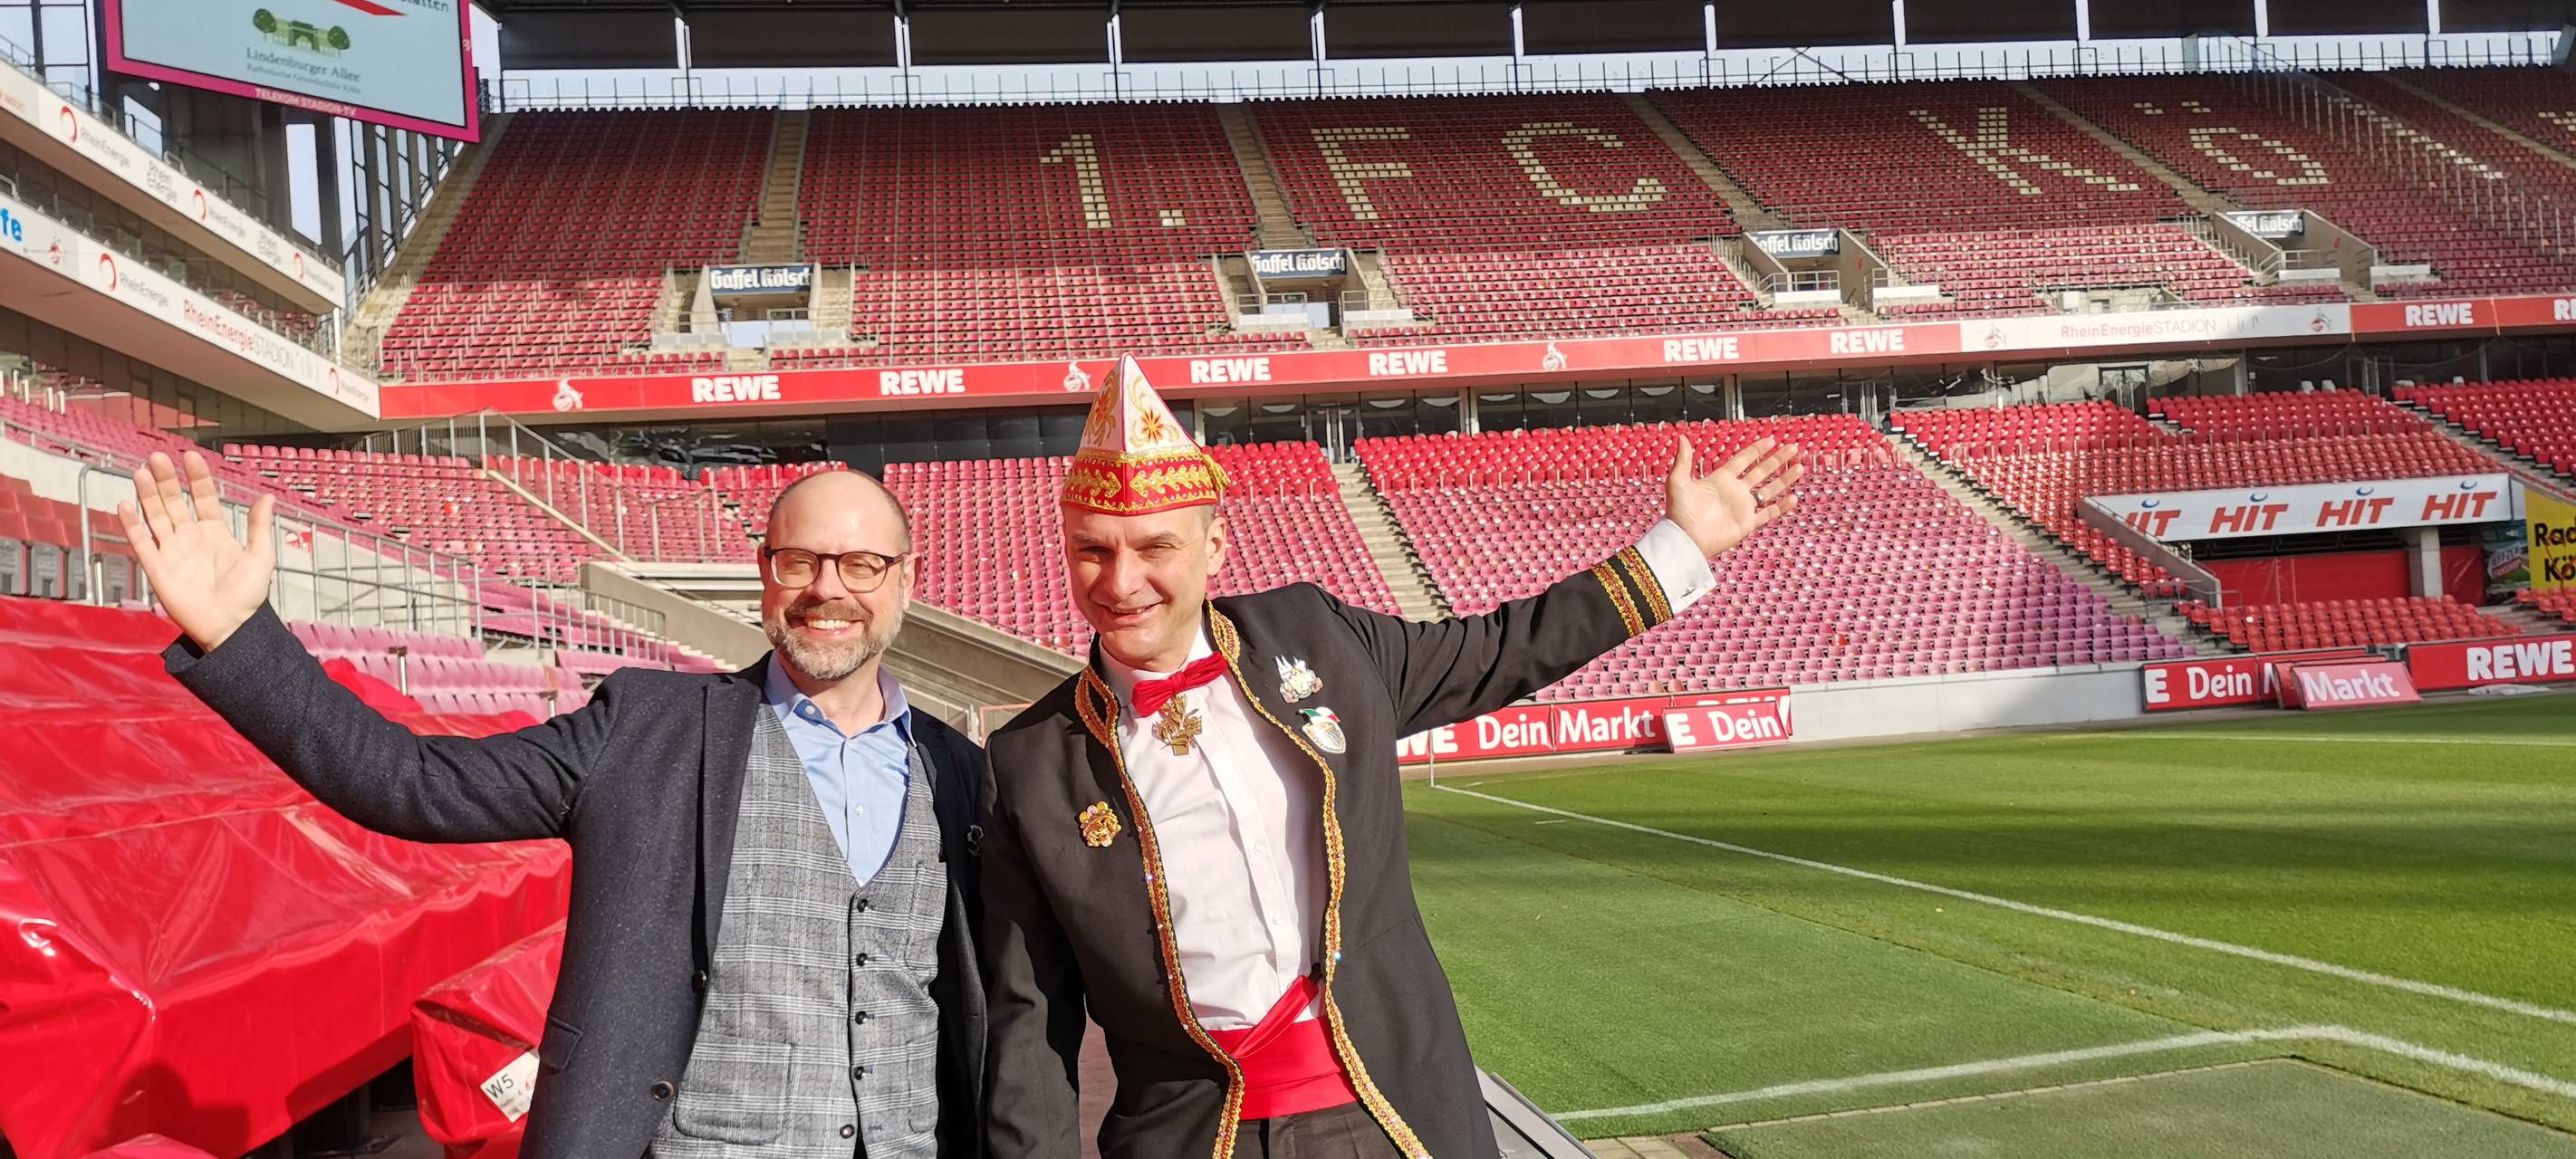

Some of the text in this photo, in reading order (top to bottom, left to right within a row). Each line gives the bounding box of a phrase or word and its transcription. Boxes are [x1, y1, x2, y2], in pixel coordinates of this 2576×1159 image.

[710, 269, 760, 290] Gaffel
[2405, 303, 2474, 326] REWE
[1663, 336, 1739, 362] REWE
[1831, 329, 1905, 355] REWE
[1190, 357, 1271, 384] REWE
[1369, 350, 1447, 377] REWE
[692, 376, 781, 403] REWE
[880, 369, 965, 396] REWE
[2211, 504, 2288, 533] HIT
[2318, 498, 2393, 526] HIT
[2423, 492, 2497, 519] HIT
[2466, 641, 2575, 681] REWE
[2144, 668, 2170, 704] E
[2186, 665, 2253, 700] Dein
[2302, 668, 2401, 703] Markt
[1396, 706, 1657, 757] WE Dein Markt
[1666, 709, 1782, 746] E Dein
